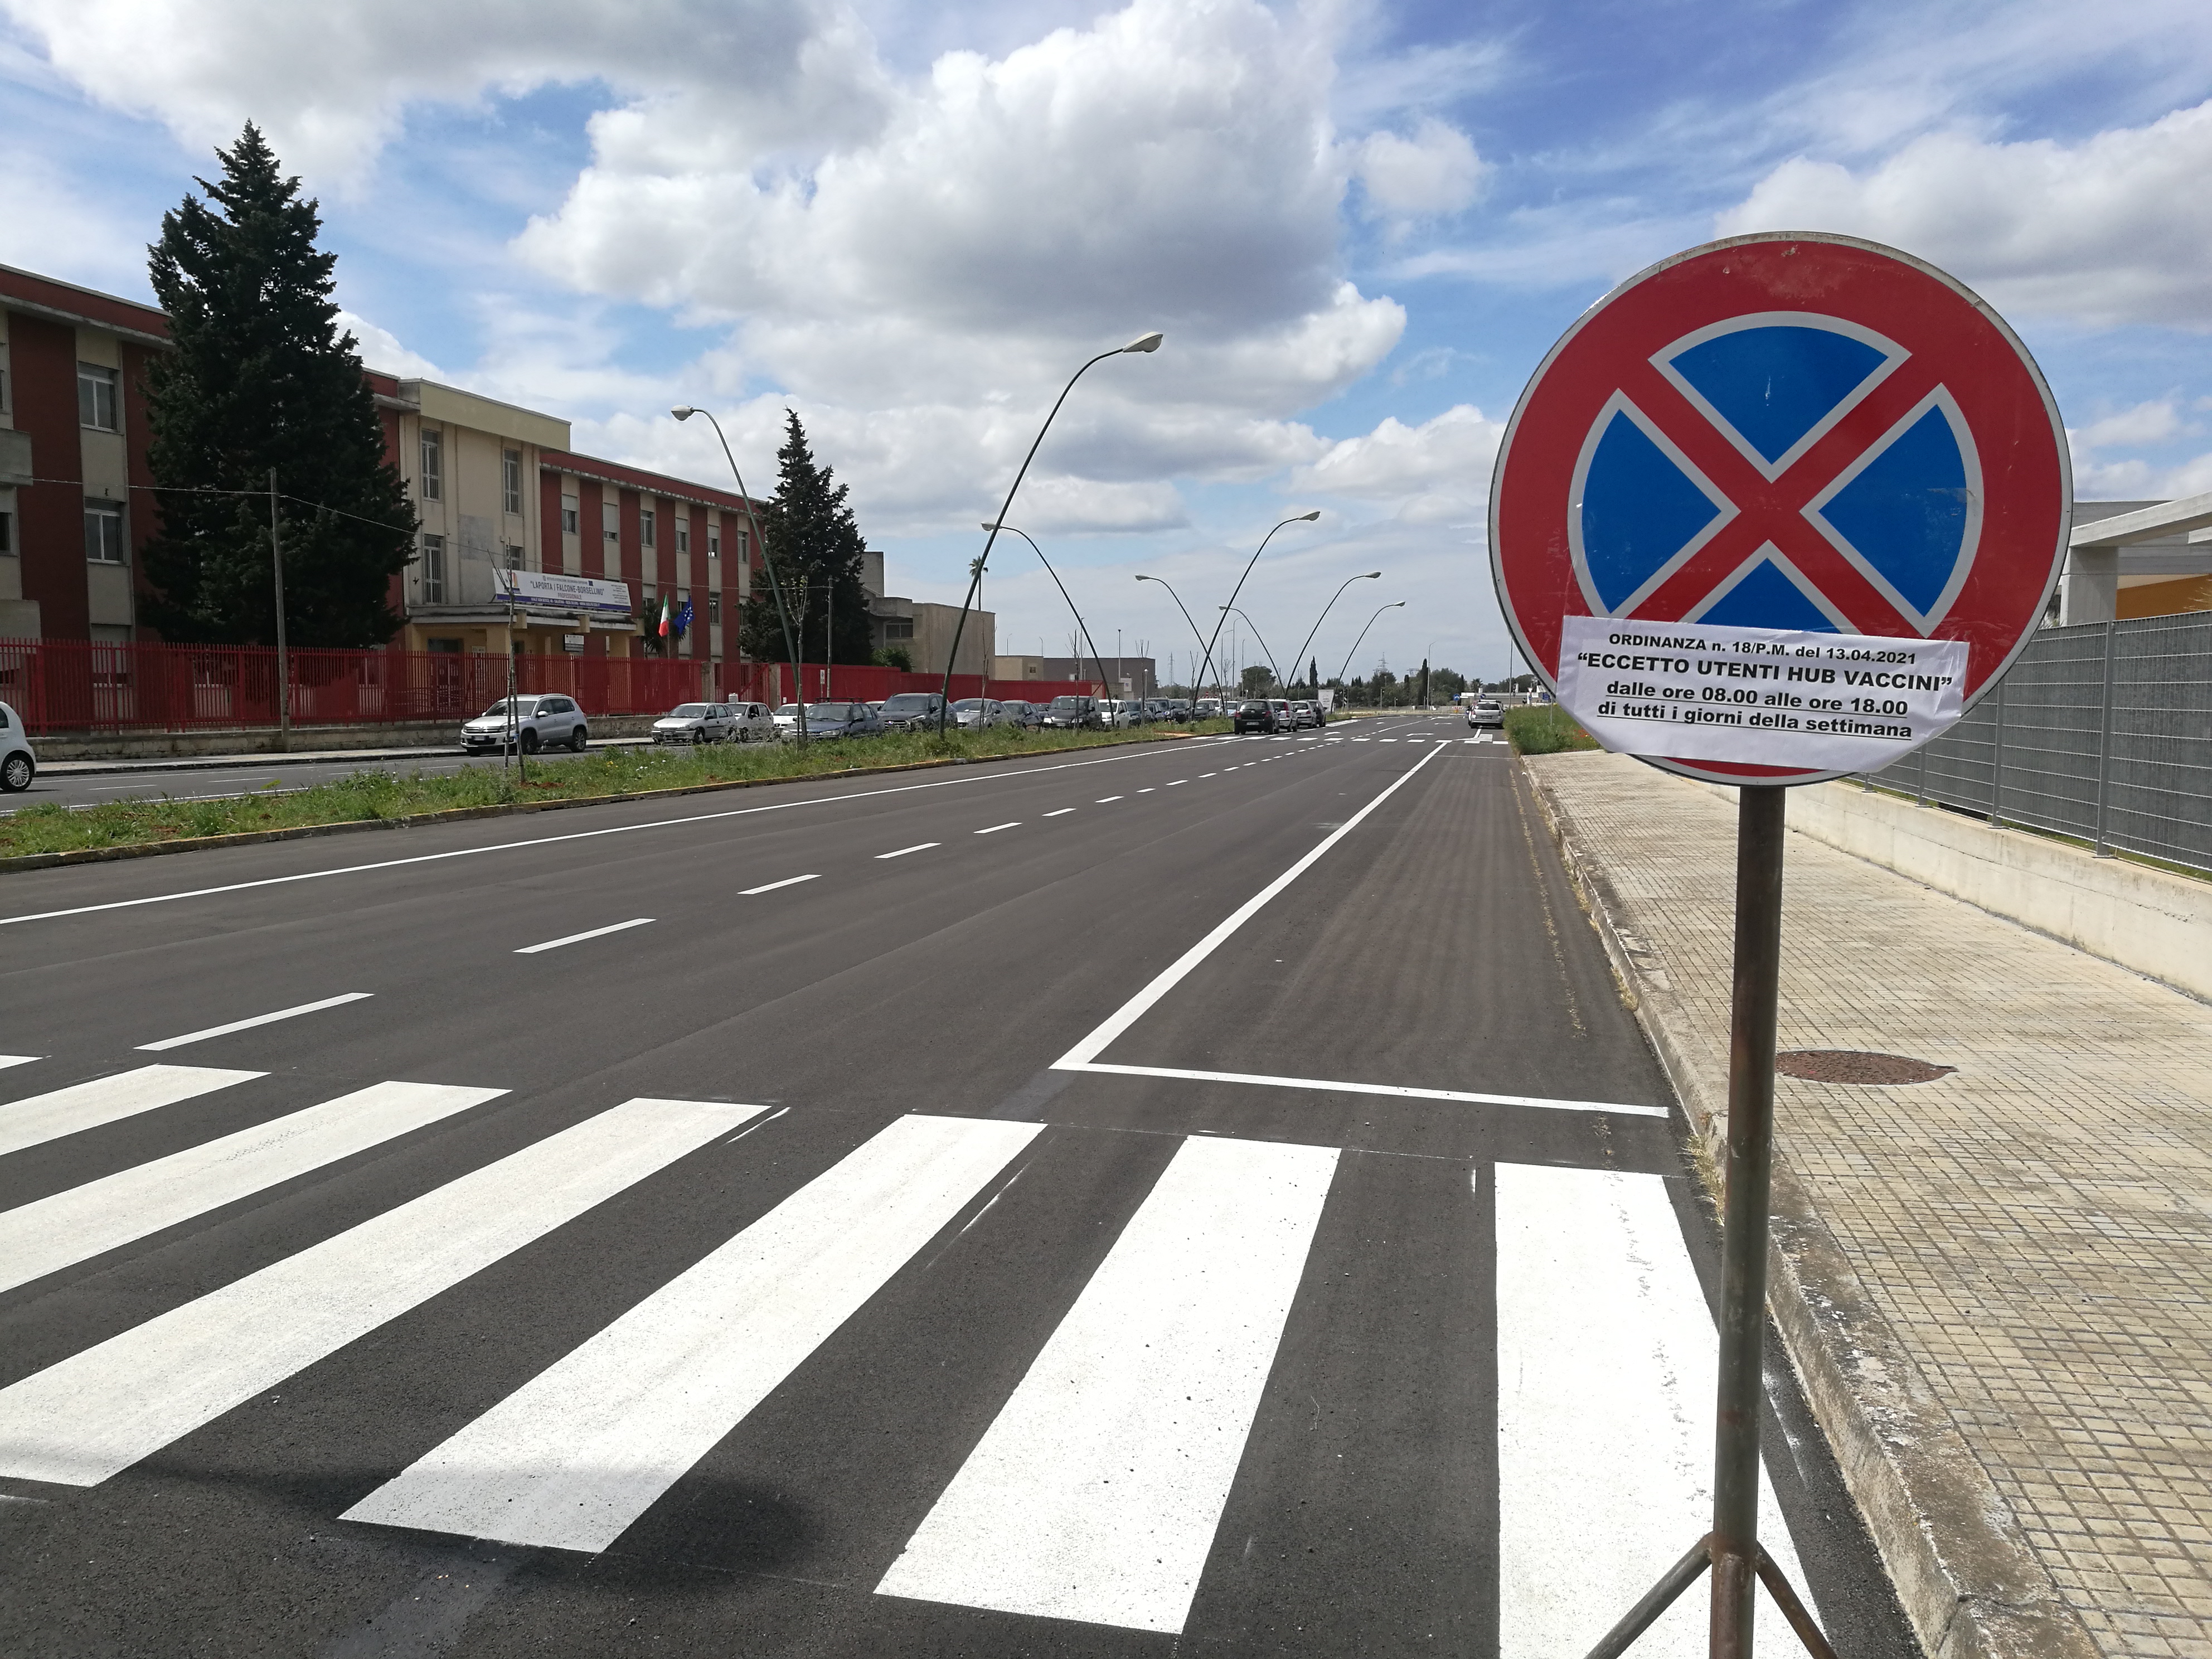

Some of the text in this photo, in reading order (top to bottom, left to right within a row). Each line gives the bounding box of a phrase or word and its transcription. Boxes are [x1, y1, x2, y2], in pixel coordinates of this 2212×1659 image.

[1609, 634, 1915, 664] ORDINANZA n. 18/P.M. del 13.04.2021
[1697, 661, 1779, 680] UTENTI
[1787, 667, 1836, 683] HUB
[1607, 681, 1908, 715] dalle ore 08.00 alle ore 18.00
[1598, 701, 1912, 737] di tutti i giorni della settimana
